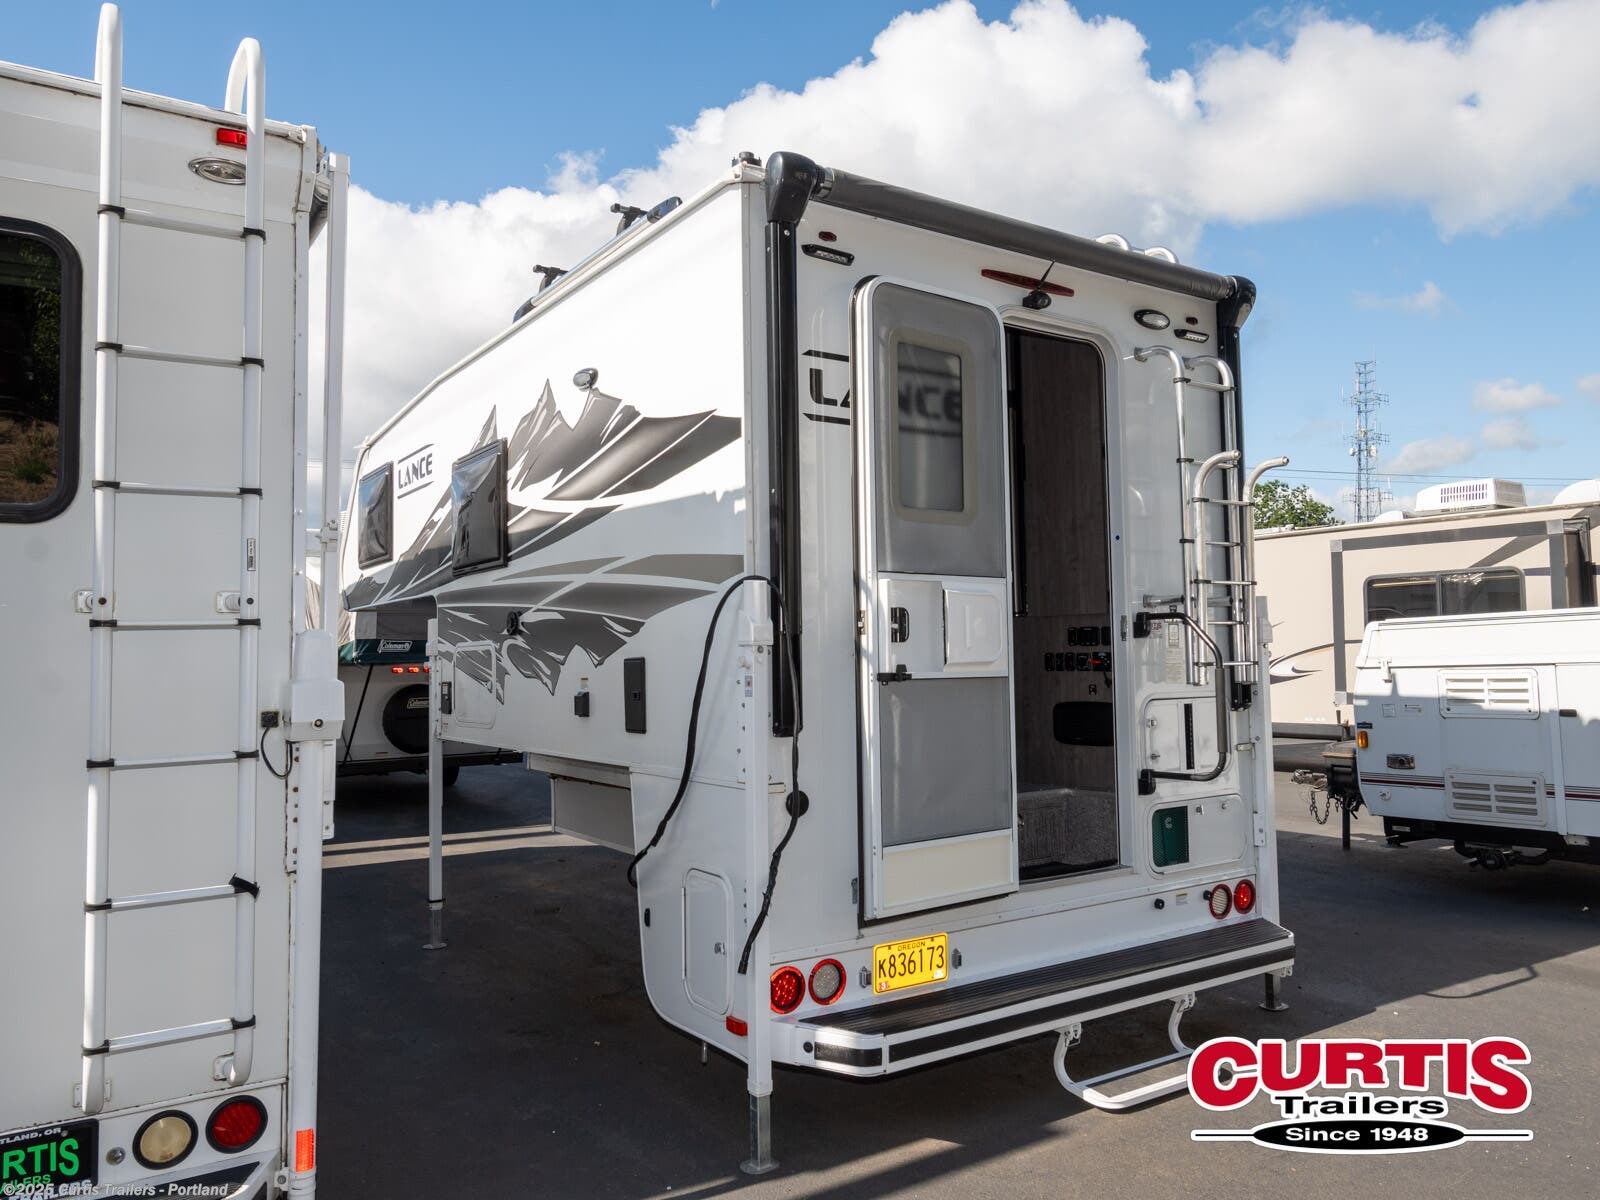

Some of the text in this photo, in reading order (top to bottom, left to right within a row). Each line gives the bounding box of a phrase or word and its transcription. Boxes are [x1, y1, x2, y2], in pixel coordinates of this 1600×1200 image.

[398, 453, 432, 489] LANCE
[898, 941, 925, 951] OREGON
[879, 945, 944, 978] K836173
[44, 1127, 62, 1136] OR
